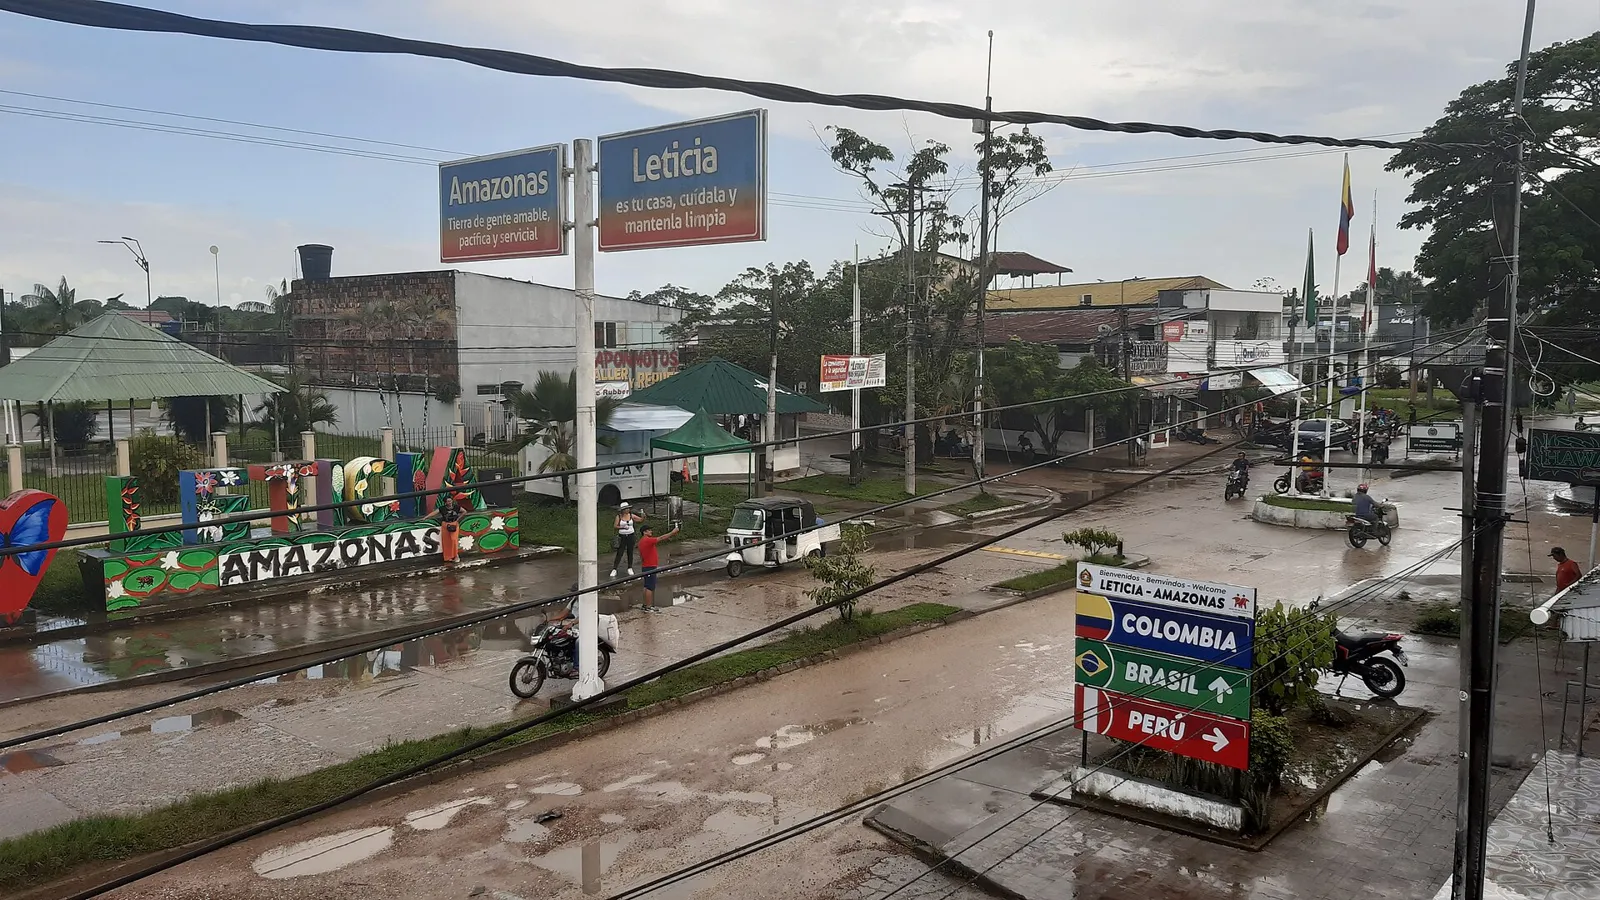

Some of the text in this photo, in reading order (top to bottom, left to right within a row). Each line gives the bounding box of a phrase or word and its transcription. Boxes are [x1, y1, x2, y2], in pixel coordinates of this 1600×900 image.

[633, 137, 718, 182] Leticia
[449, 170, 549, 206] Amazonas
[616, 186, 738, 213] es tu casa, cuídala y
[448, 207, 550, 230] Tierra de gente amable,
[625, 208, 726, 234] mantenla limpia
[460, 226, 538, 250] pacífica y servicial
[595, 351, 634, 368] APON
[595, 368, 628, 381] ALLER
[106, 446, 487, 553] LETICIA
[221, 527, 441, 586] AMAZONAS
[1100, 570, 1140, 582] Bienvenidos
[1146, 576, 1186, 588] Bemvindos
[1192, 583, 1227, 595] Welcome
[1100, 579, 1144, 596] LETICIA
[1153, 588, 1226, 609] AMAZONAS
[1122, 612, 1238, 653] COLOMBIA
[1124, 661, 1199, 696] BRASIL
[1128, 710, 1186, 741] PERÚ
